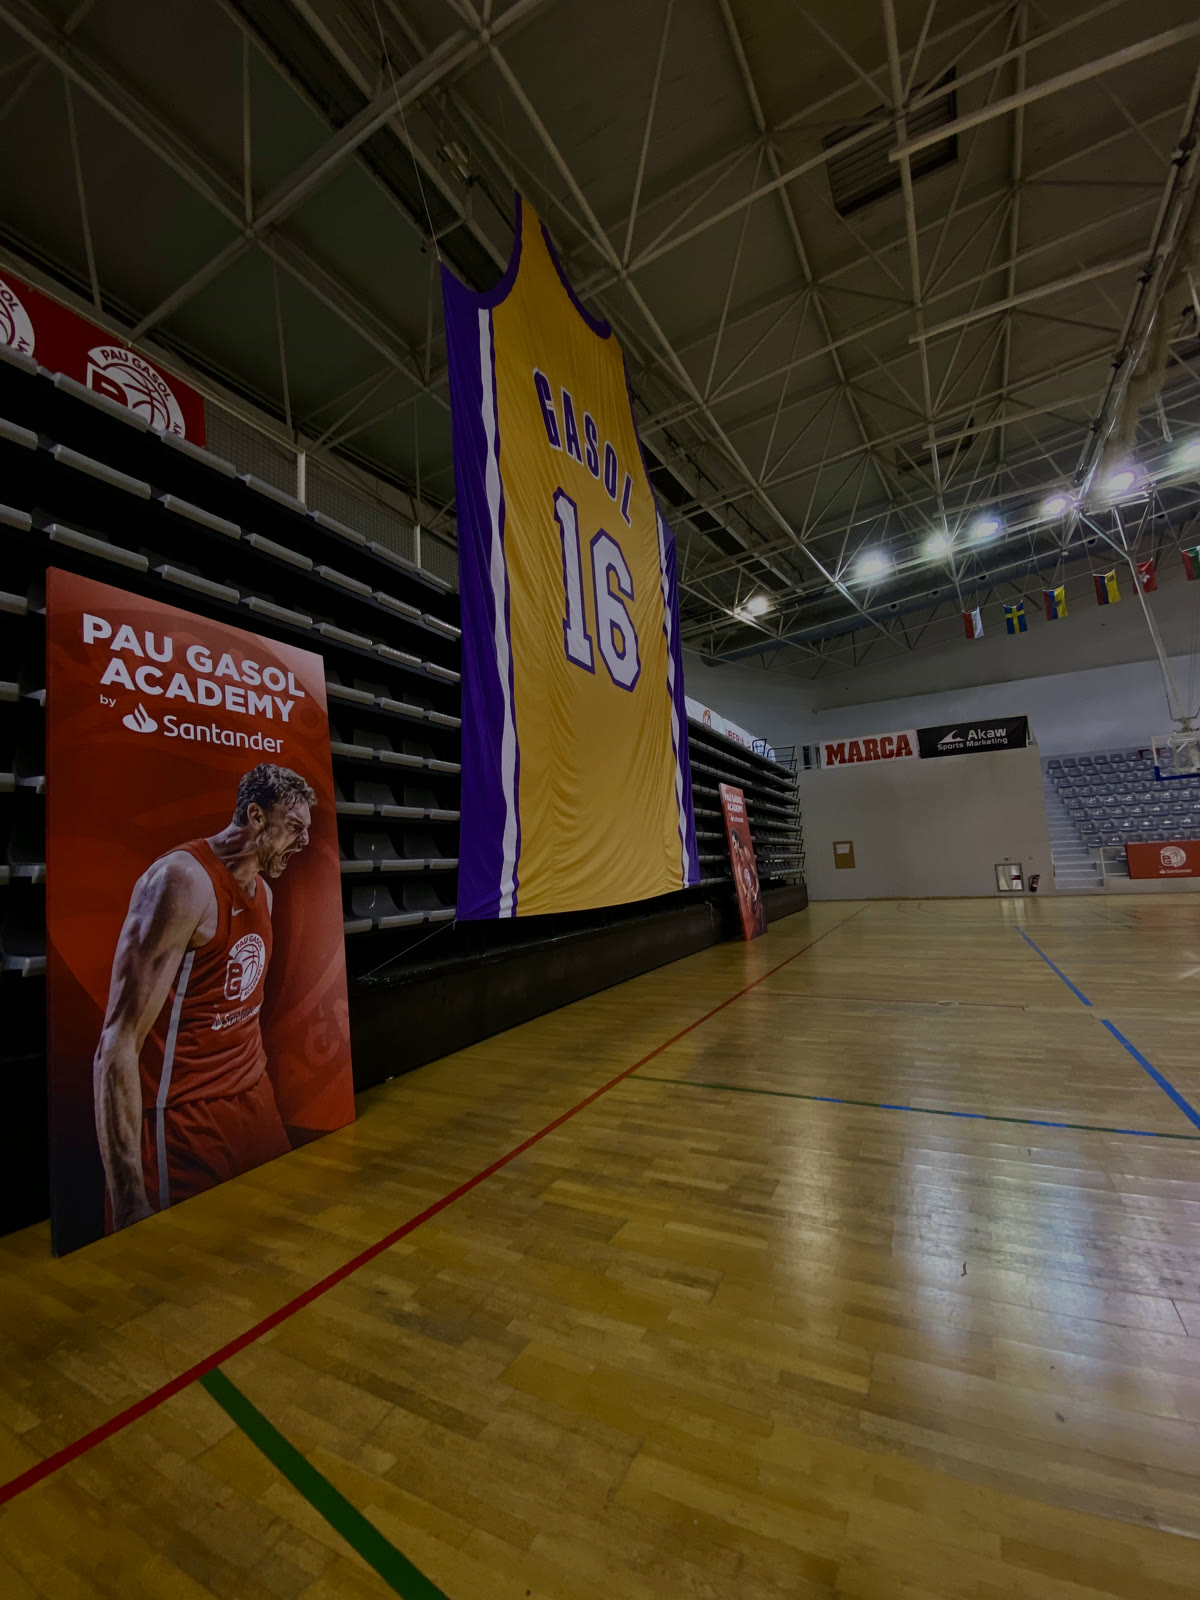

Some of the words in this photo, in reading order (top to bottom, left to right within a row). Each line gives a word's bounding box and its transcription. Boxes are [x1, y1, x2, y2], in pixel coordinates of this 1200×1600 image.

[101, 348, 129, 363] PAU
[132, 357, 172, 402] GASOL
[532, 366, 635, 528] GASOL
[553, 486, 642, 693] 16
[82, 612, 174, 663] PAU
[186, 644, 305, 698] GASOL
[99, 656, 295, 723] ACADEMY
[99, 693, 117, 708] by
[163, 714, 284, 754] Santander
[824, 734, 913, 766] MARCA
[936, 741, 964, 752] Sports
[966, 736, 1008, 748] Marketing
[967, 726, 1007, 740] Akaw
[234, 935, 249, 952] PAU
[249, 934, 264, 951] GASOL
